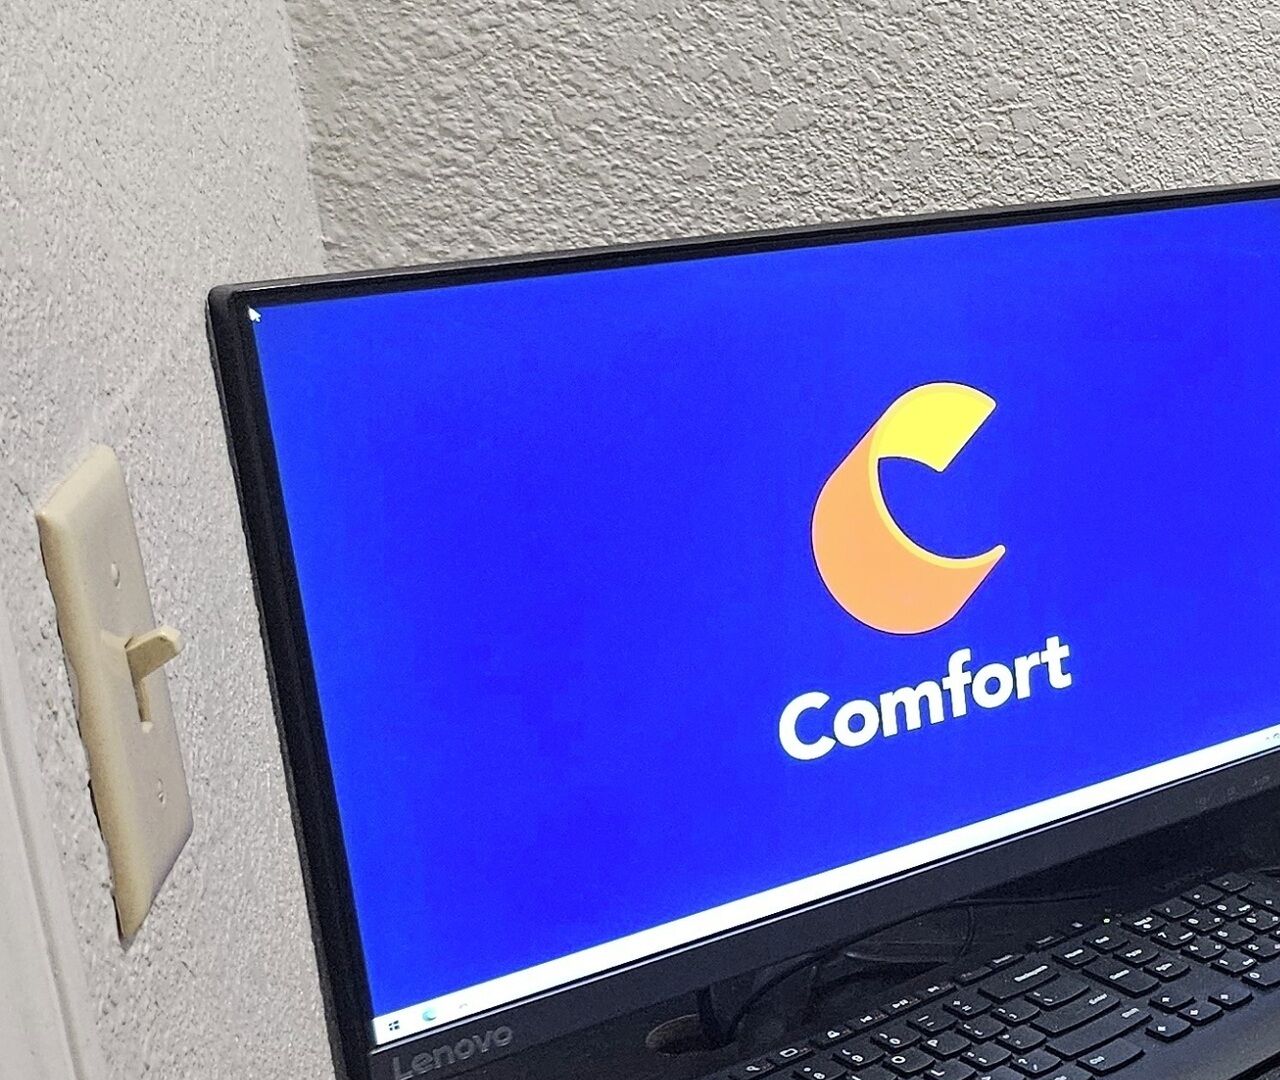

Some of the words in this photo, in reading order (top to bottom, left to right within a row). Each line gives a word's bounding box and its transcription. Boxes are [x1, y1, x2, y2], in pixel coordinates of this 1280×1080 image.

[778, 636, 1073, 761] Comfort
[891, 1055, 906, 1064] O
[930, 1069, 945, 1077] L
